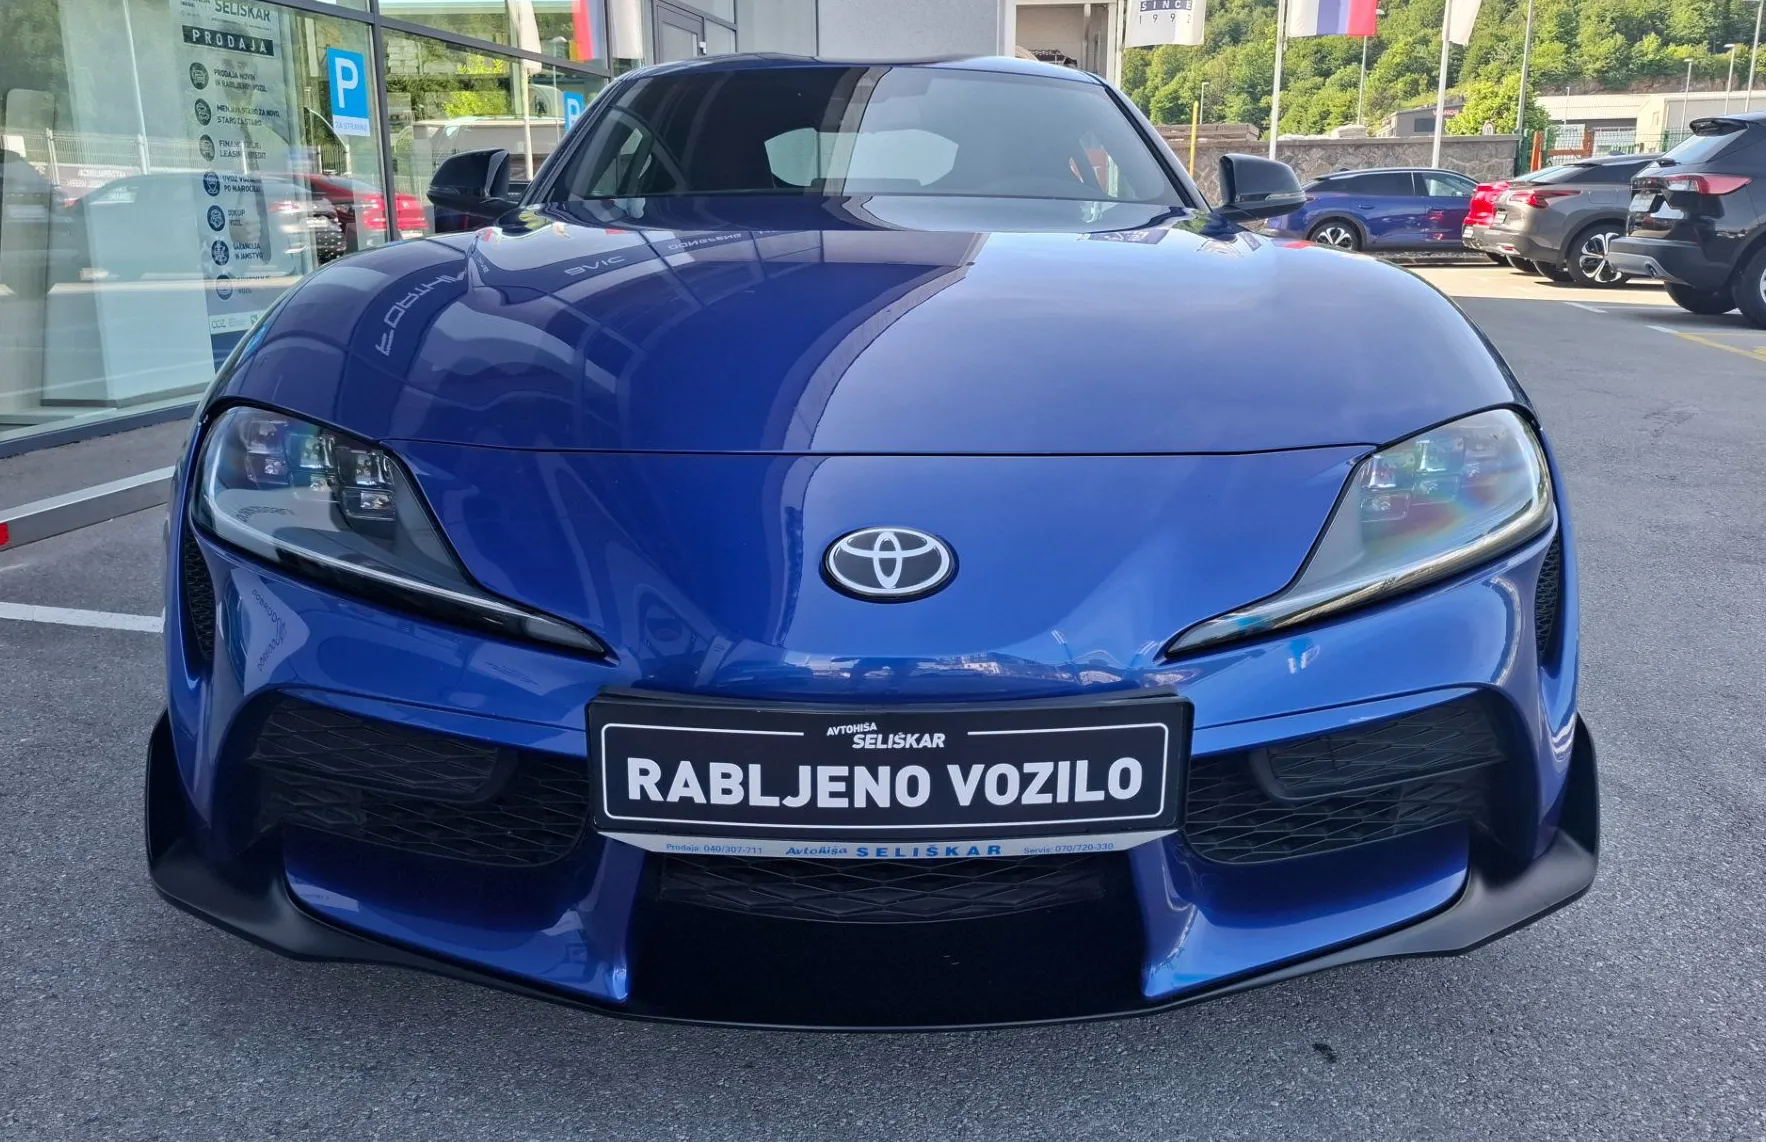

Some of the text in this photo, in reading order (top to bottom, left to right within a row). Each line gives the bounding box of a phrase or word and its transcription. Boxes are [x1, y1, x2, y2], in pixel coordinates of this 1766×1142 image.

[1141, 1, 1191, 10] SINCE
[192, 29, 267, 53] PRODAJA
[334, 57, 358, 108] P
[826, 722, 877, 736] AVTOHIŠA
[852, 732, 945, 749] SELIŠKAR
[627, 757, 1142, 808] RABLJENO VOZILO
[856, 845, 1002, 858] SELIŠKAR
